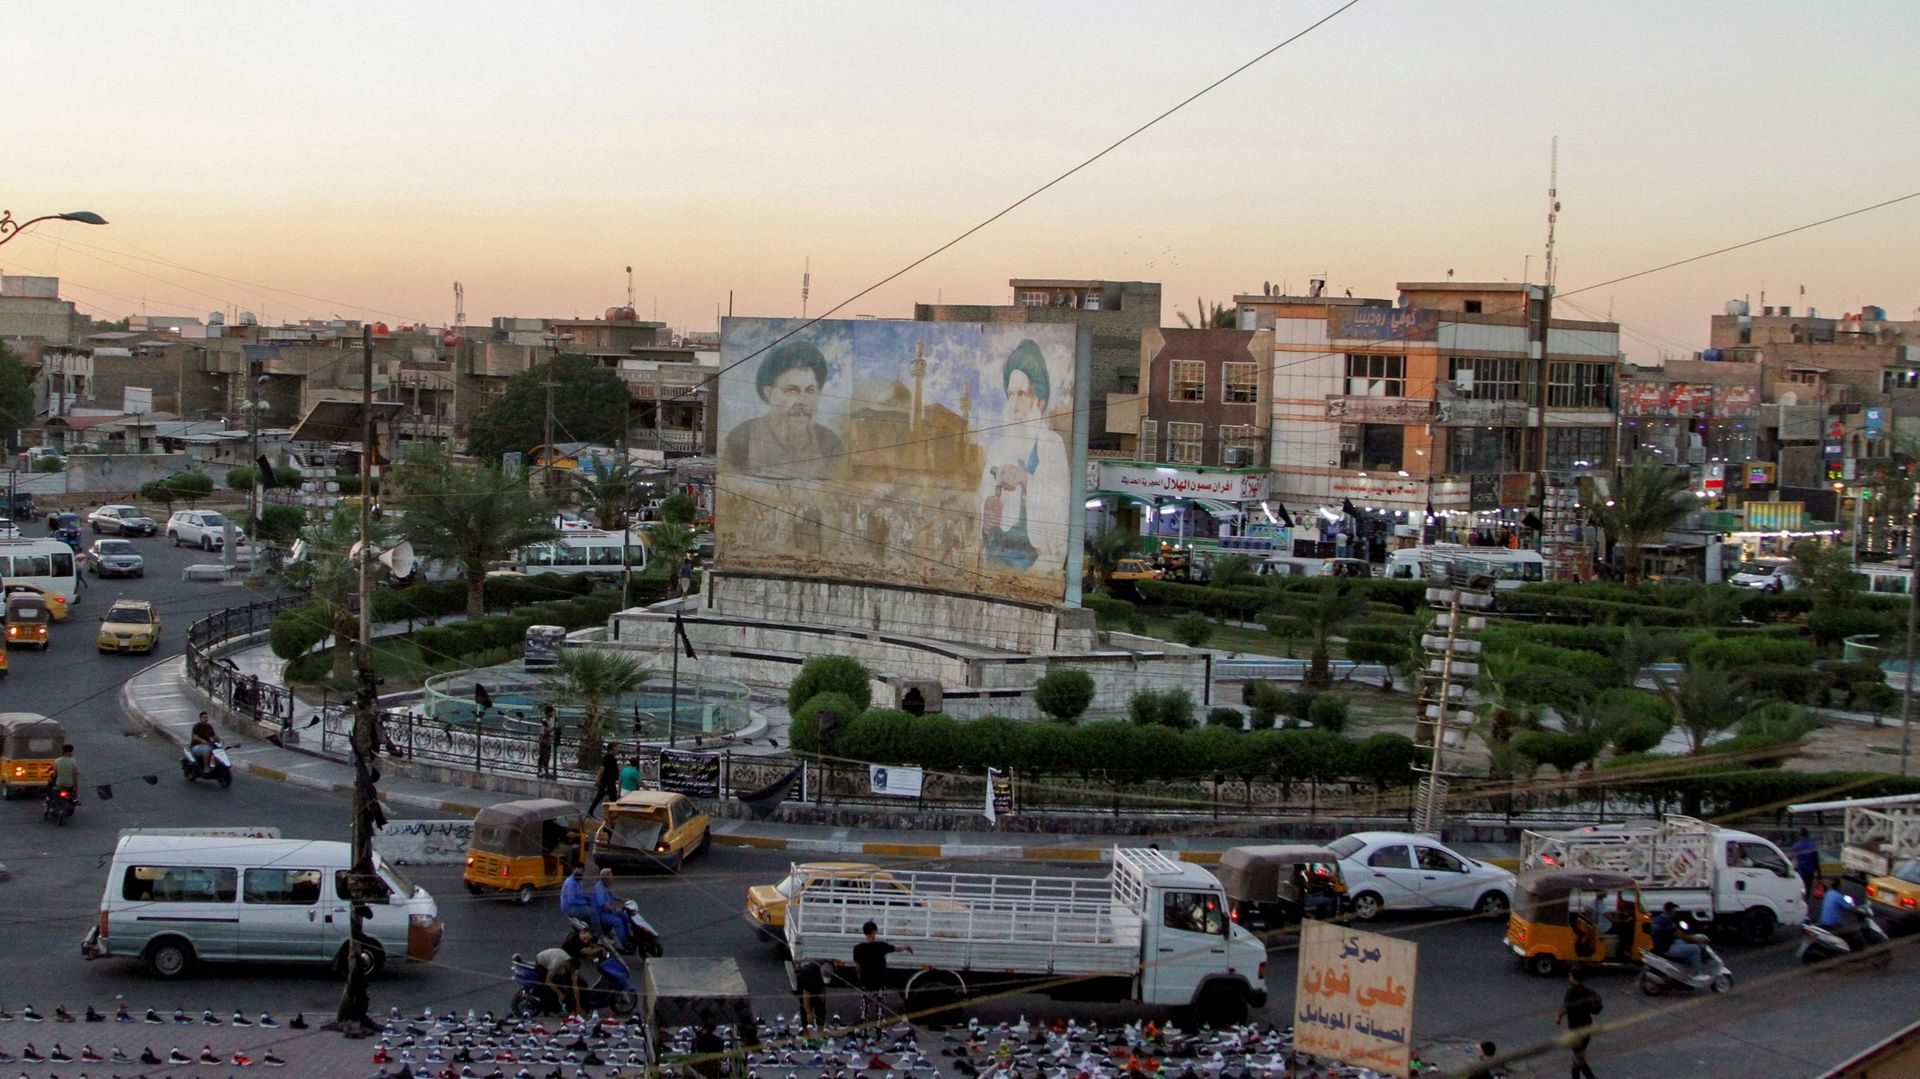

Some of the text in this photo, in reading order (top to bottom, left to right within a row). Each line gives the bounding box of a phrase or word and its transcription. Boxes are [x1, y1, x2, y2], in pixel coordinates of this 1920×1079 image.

[1164, 477, 1190, 492] الهلال
[1339, 937, 1381, 963] مركز
[1303, 965, 1407, 1013] علي فون
[1299, 1004, 1405, 1043] لصيانة الموبايل
